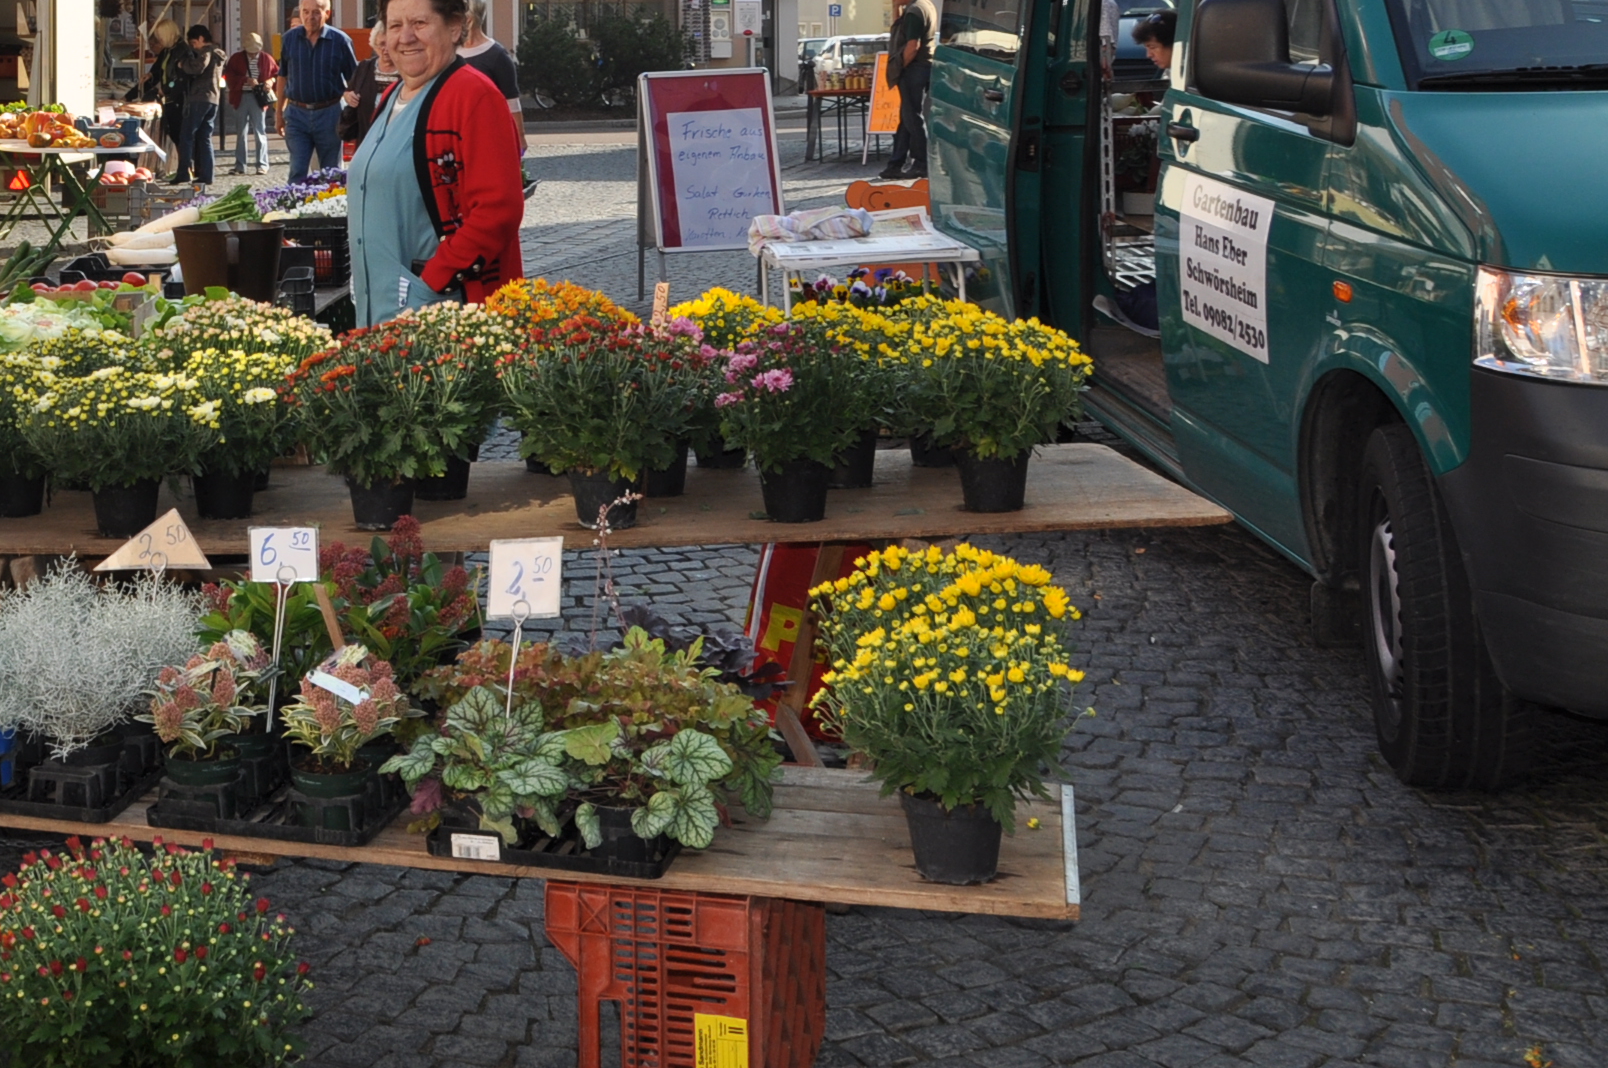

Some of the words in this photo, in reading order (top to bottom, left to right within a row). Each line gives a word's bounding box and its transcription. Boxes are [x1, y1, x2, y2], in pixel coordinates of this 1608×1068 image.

[832, 6, 840, 15] P
[1443, 31, 1457, 45] 4
[682, 120, 733, 141] Frische
[740, 126, 764, 137] aus
[678, 150, 722, 166] eigenem
[707, 207, 750, 220] Rettich
[1193, 184, 1259, 230] Gartenbau
[1195, 224, 1220, 255] Hans
[1222, 235, 1247, 266] Eber
[1186, 257, 1257, 309] Schwörsheim
[1183, 289, 1201, 318] Tel.
[1203, 302, 1265, 349] 09082/2530
